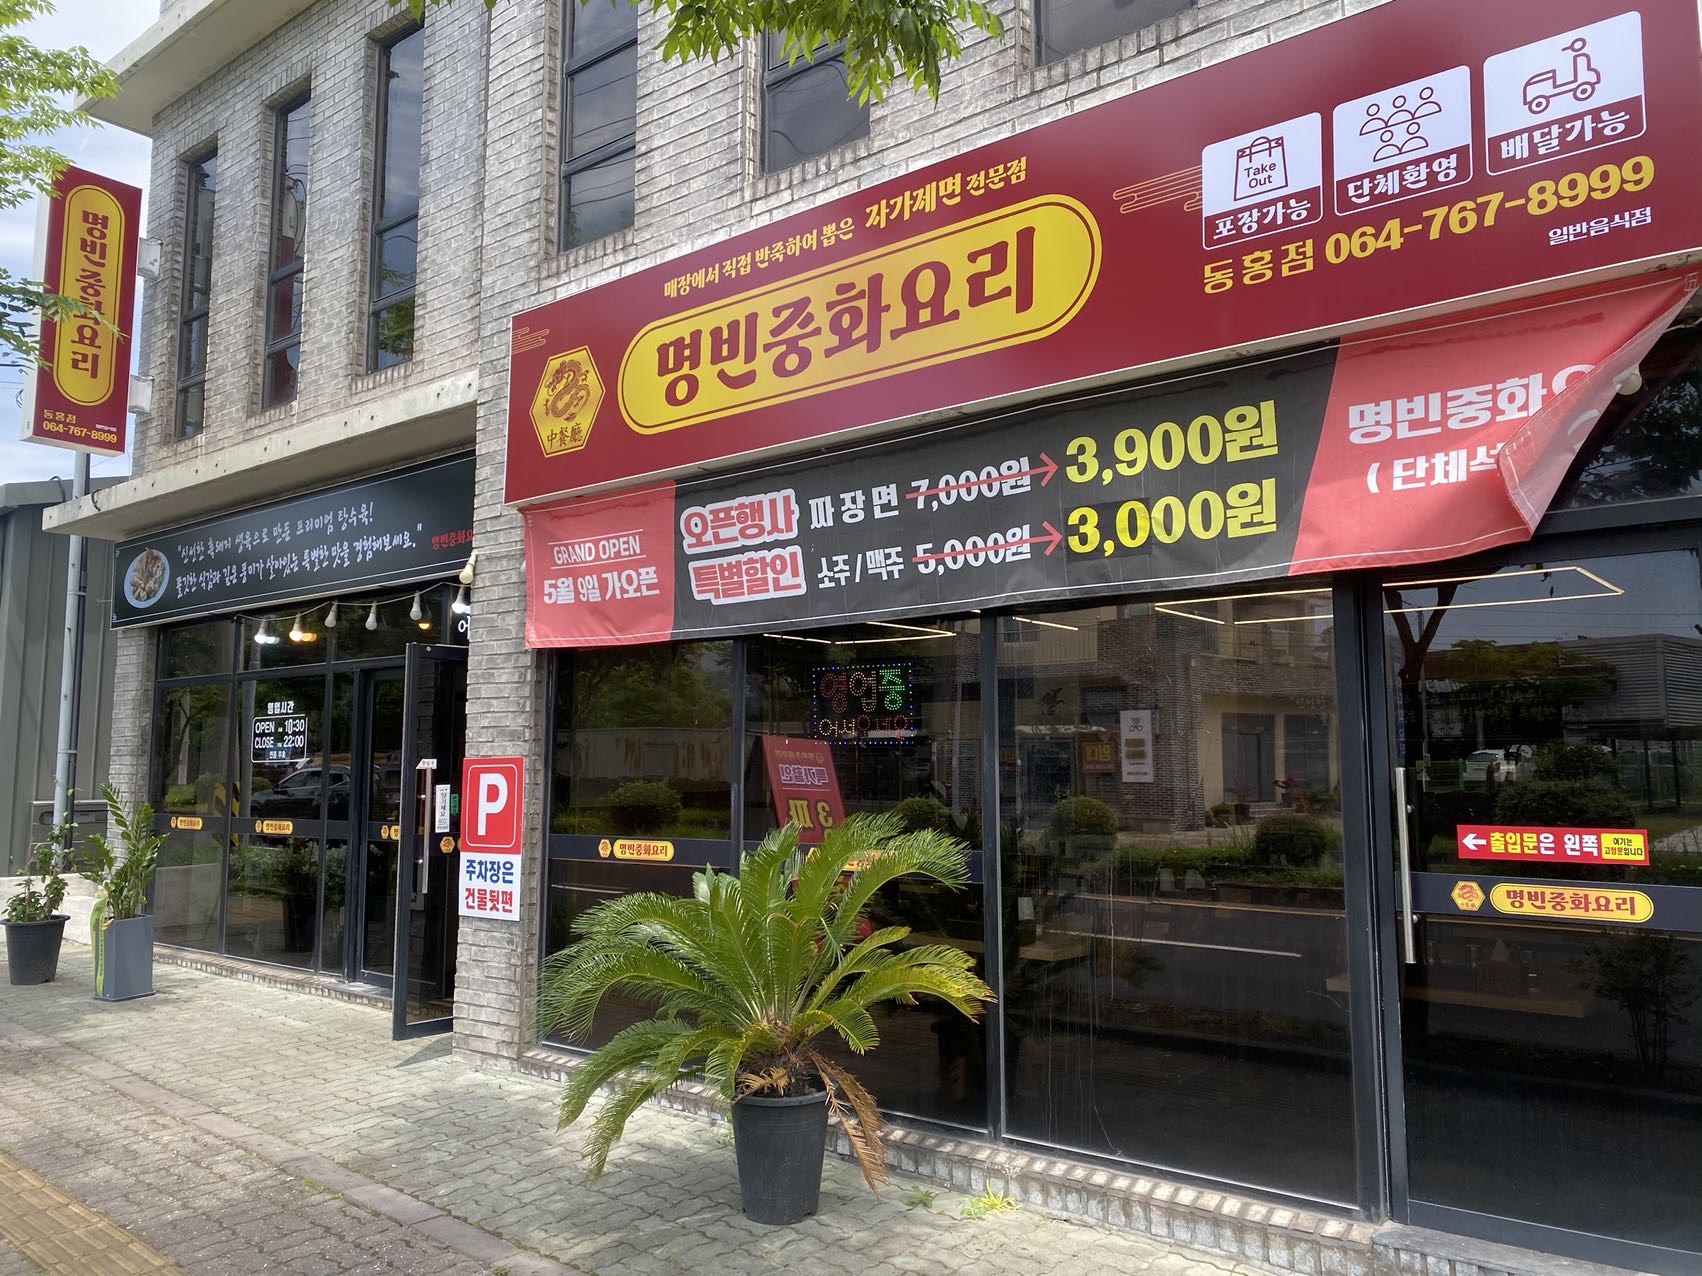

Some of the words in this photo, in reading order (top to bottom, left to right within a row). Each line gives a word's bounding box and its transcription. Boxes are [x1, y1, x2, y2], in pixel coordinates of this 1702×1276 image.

[1500, 109, 1630, 160] 배달가능
[1244, 161, 1276, 178] Take
[1248, 174, 1273, 189] Out
[1348, 154, 1458, 204] 단체환영
[664, 263, 720, 298] 매장에서
[722, 251, 752, 279] 직접
[755, 229, 818, 269] 반죽하여
[820, 217, 855, 243] 뽑은
[865, 172, 962, 229] 자가제면
[966, 156, 1028, 193] 전문점
[1203, 238, 1315, 295] 동홍점
[1325, 155, 1655, 266] 064-767-8999
[1212, 198, 1312, 240] 포장가능
[1547, 207, 1653, 247] 일반음식점
[71, 209, 110, 379] 명빈중화요리
[656, 226, 1037, 407] 명빈중화요리
[43, 421, 118, 443] 064-767-8999
[809, 483, 900, 530] 짜장면
[911, 456, 1032, 511] 7,000원
[1066, 400, 1278, 485] 3,900원
[207, 536, 231, 559] 흑돼지
[273, 521, 291, 544] 만든
[296, 511, 334, 535] 프리미엄
[338, 501, 374, 531] 탕수육!
[682, 492, 797, 552] 오픈행사
[916, 524, 1032, 576] 5,000원
[1067, 477, 1277, 557] 3,000원
[199, 569, 222, 591] 식감과
[222, 563, 238, 587] 깊은
[240, 560, 264, 584] 풍미가
[266, 553, 299, 580] 살아있는
[302, 545, 329, 572] 특별한
[331, 541, 350, 568] 맛을
[553, 542, 596, 565] GRAND
[599, 535, 641, 559] OPEN
[543, 577, 575, 604] 5월
[577, 574, 602, 602] 9일
[602, 566, 660, 600] 가오픈
[691, 548, 803, 603] 특별할인
[267, 701, 295, 714] 영업시간
[820, 669, 906, 714] 영업중
[254, 737, 274, 748] CLOSE
[283, 735, 304, 747] 22:00
[255, 721, 275, 733] OPEN
[477, 773, 508, 836] P
[619, 843, 668, 857] 명빈중화요리
[1489, 831, 1555, 855] 출입문은
[1563, 833, 1598, 856] 왼쪽
[1604, 846, 1643, 856] 고정문입니다
[1613, 837, 1633, 846] 여기는
[465, 859, 514, 884] 주차장은
[465, 888, 513, 914] 건물뒷편
[1505, 889, 1636, 915] 명빈중화요리
